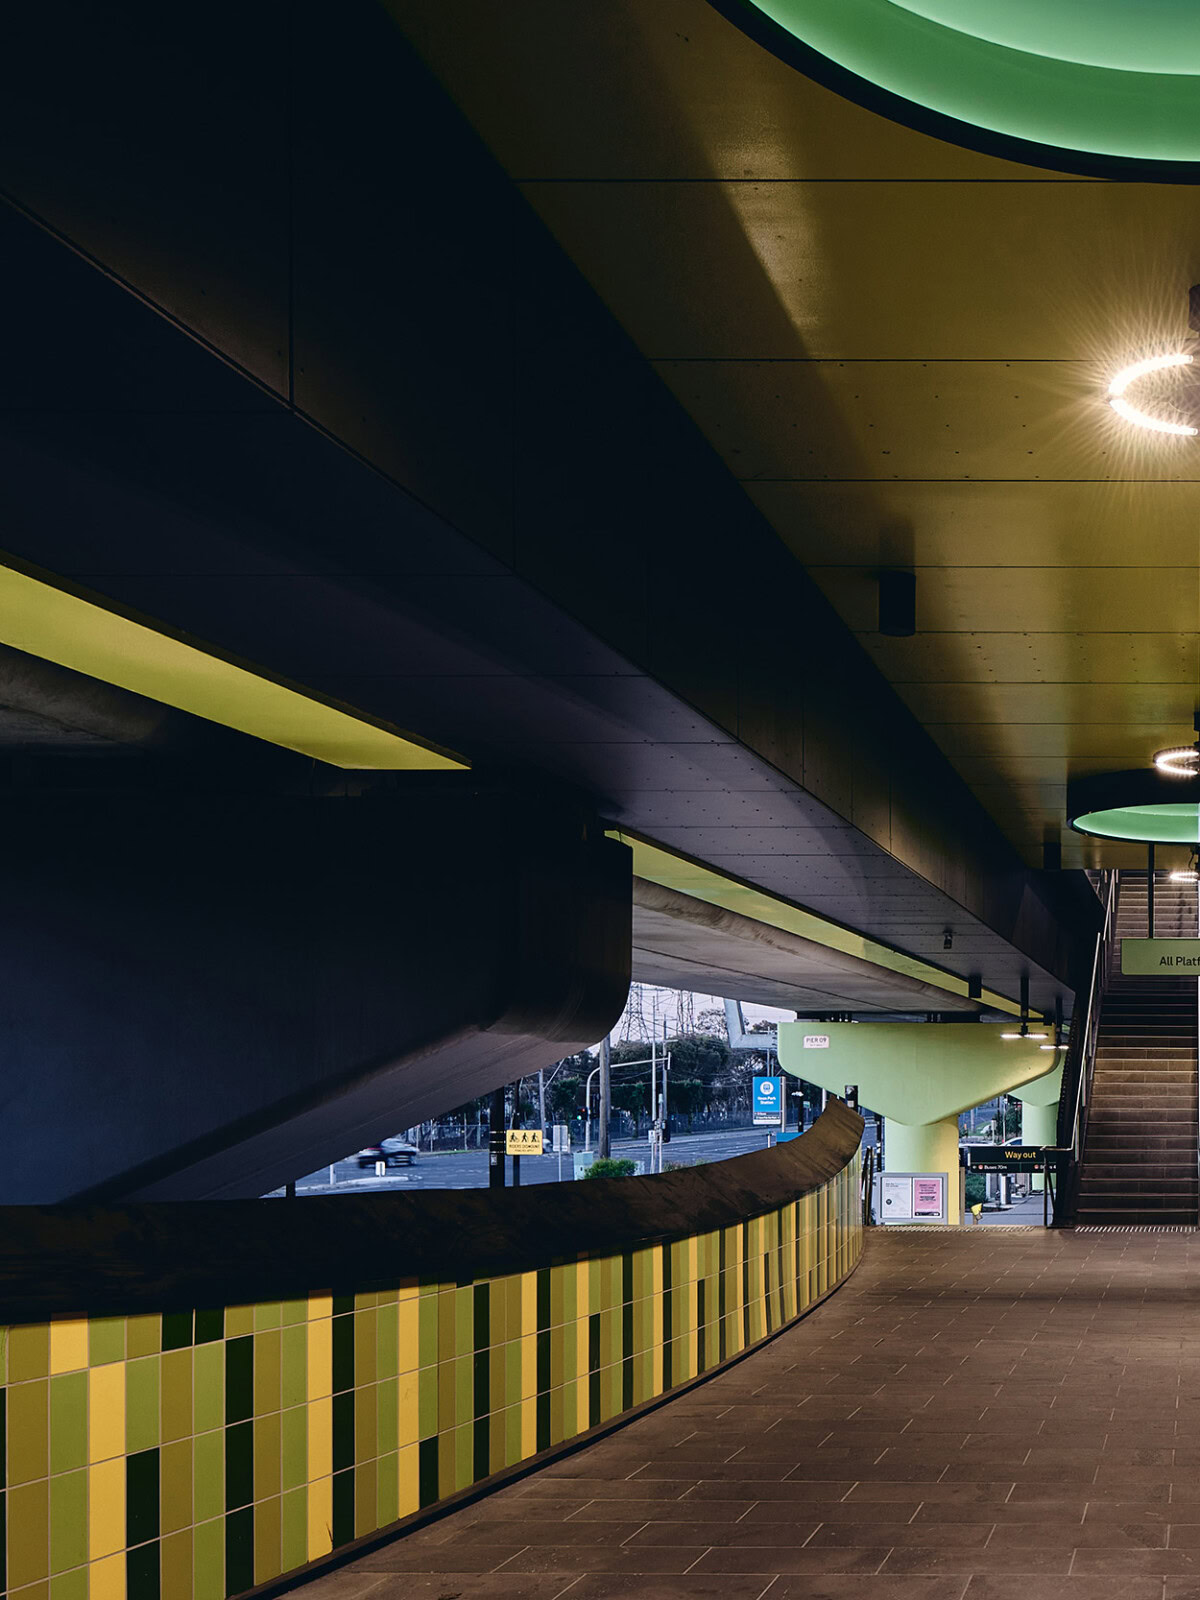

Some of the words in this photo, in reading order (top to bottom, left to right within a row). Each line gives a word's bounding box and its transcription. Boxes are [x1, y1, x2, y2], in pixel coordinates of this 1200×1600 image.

[1159, 956, 1173, 967] All
[1004, 1151, 1022, 1160] Way
[1023, 1151, 1036, 1159] out
